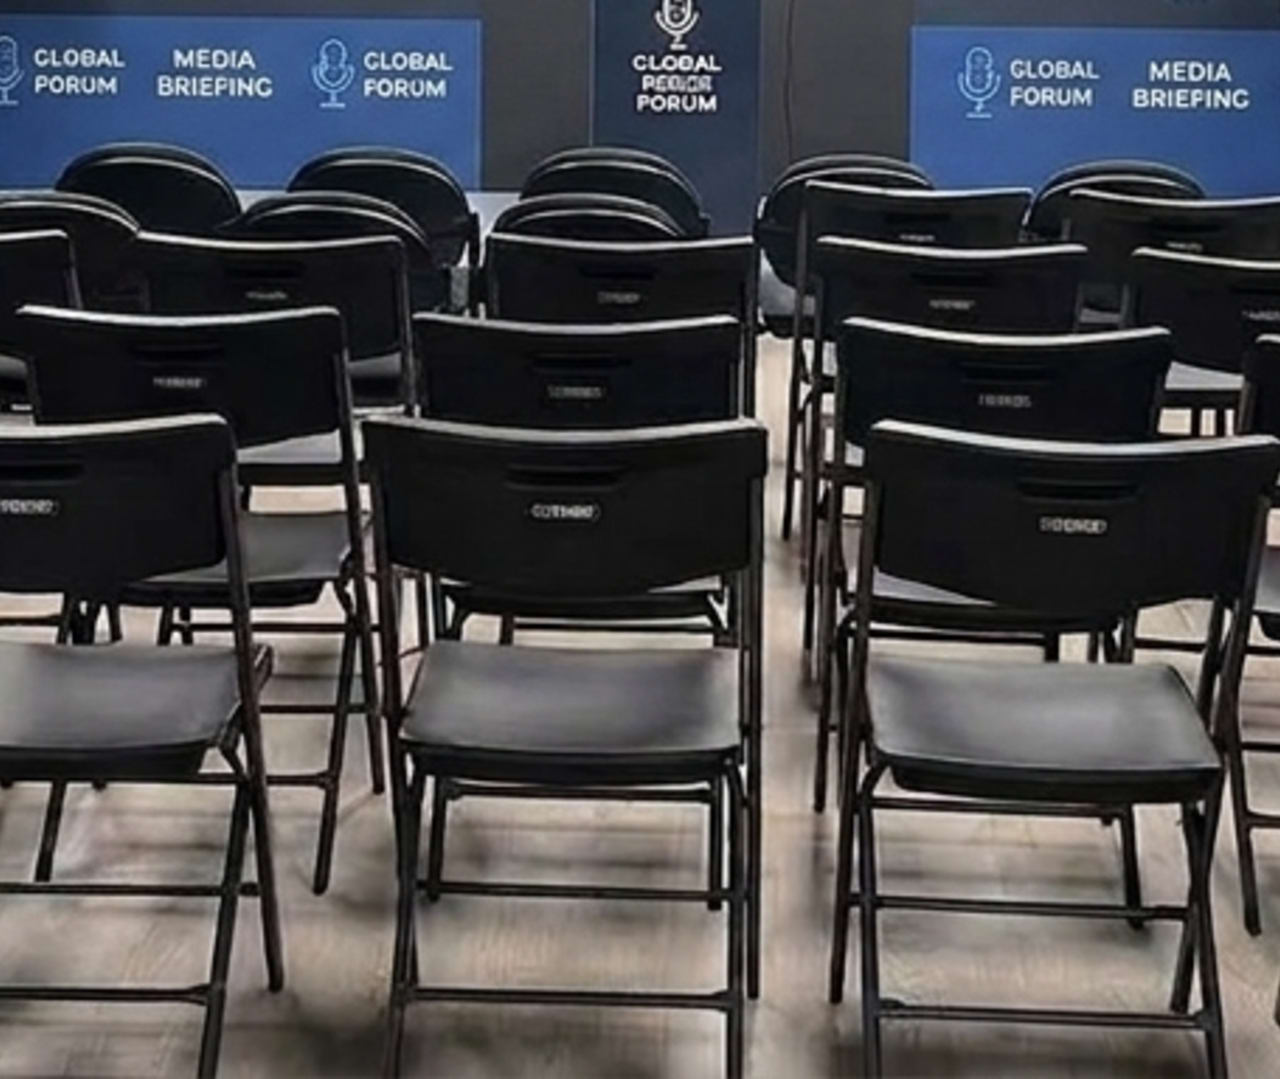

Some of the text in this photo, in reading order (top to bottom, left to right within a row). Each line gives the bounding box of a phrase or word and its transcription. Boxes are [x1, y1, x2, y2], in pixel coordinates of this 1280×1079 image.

[173, 48, 256, 70] MEDIA
[363, 51, 453, 71] GLOBAL
[1009, 59, 1100, 80] GLOBAL
[1149, 61, 1232, 82] MEDIA
[363, 77, 446, 98] FORUM
[1010, 86, 1092, 107] FORUM
